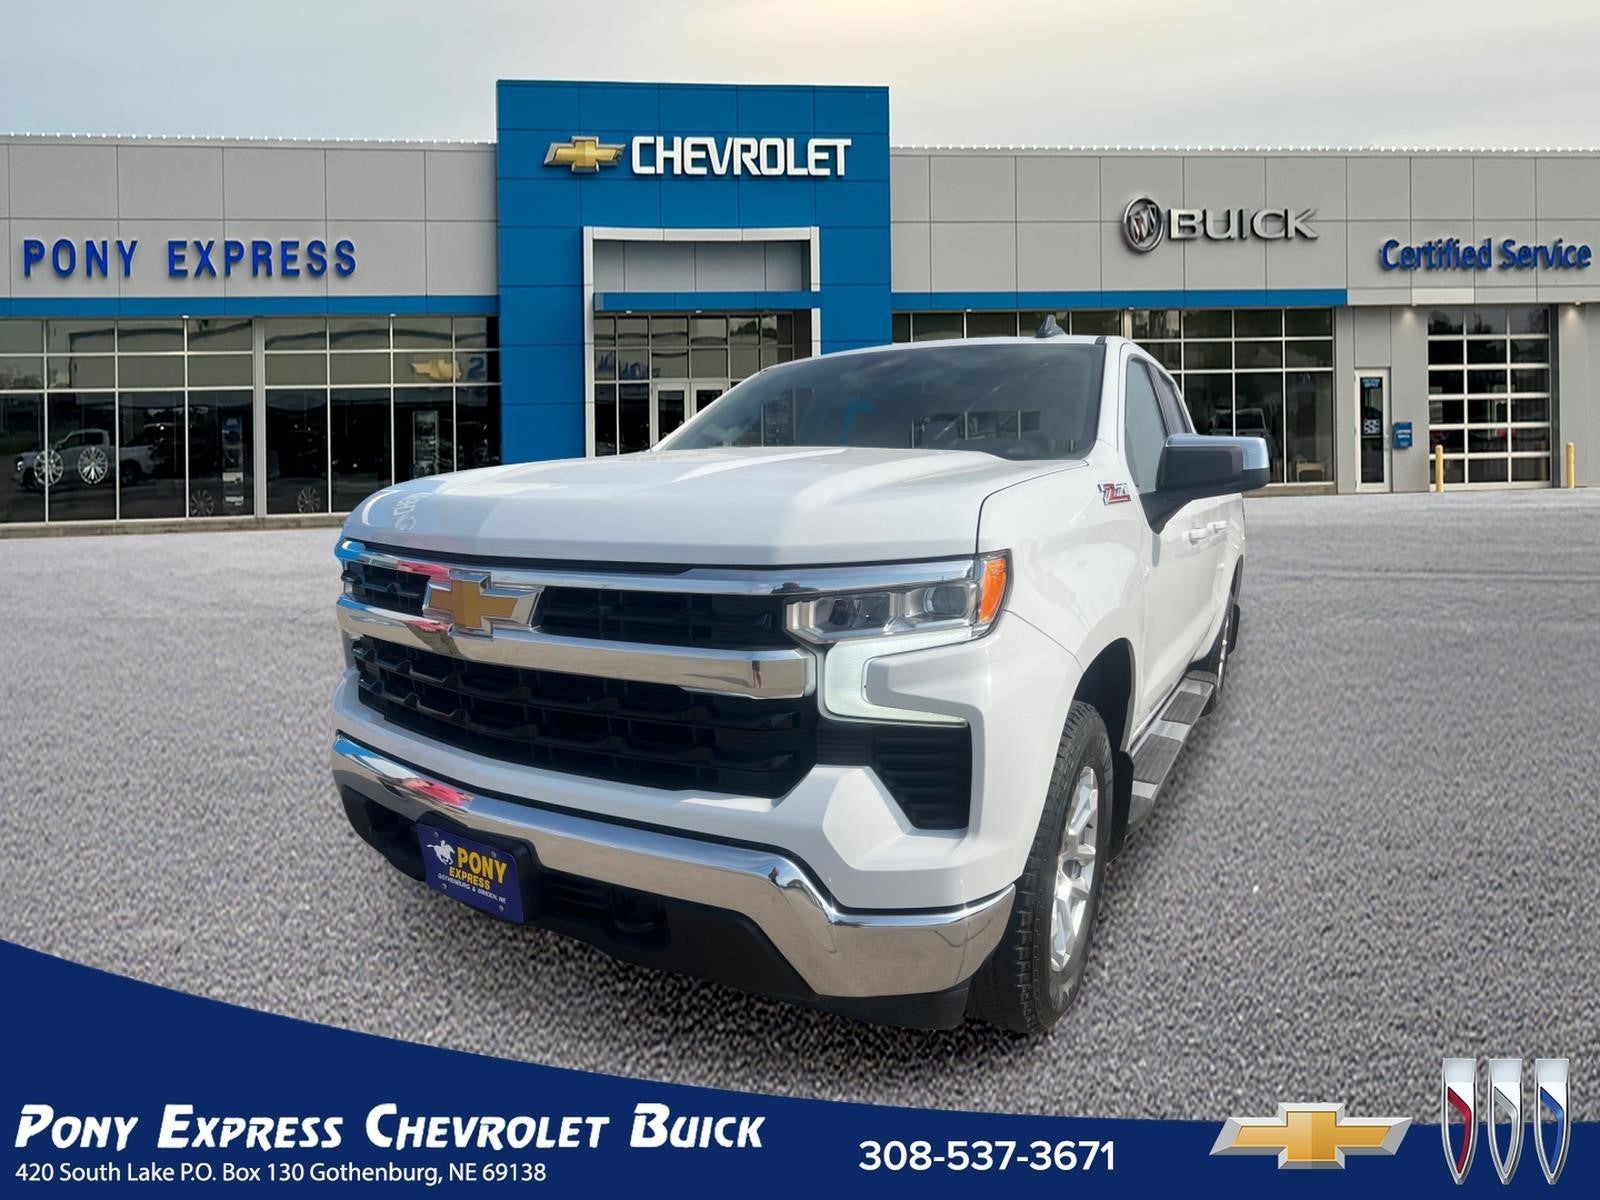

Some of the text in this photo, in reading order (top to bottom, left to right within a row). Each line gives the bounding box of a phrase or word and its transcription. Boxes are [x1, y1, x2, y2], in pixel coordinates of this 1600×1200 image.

[631, 135, 852, 177] CHEVROLET
[1169, 207, 1319, 241] BUICK
[23, 239, 357, 278] PONY EXPRESS
[1380, 238, 1592, 272] Certified Service
[449, 866, 491, 891] EXPRESS
[456, 846, 508, 884] PONY
